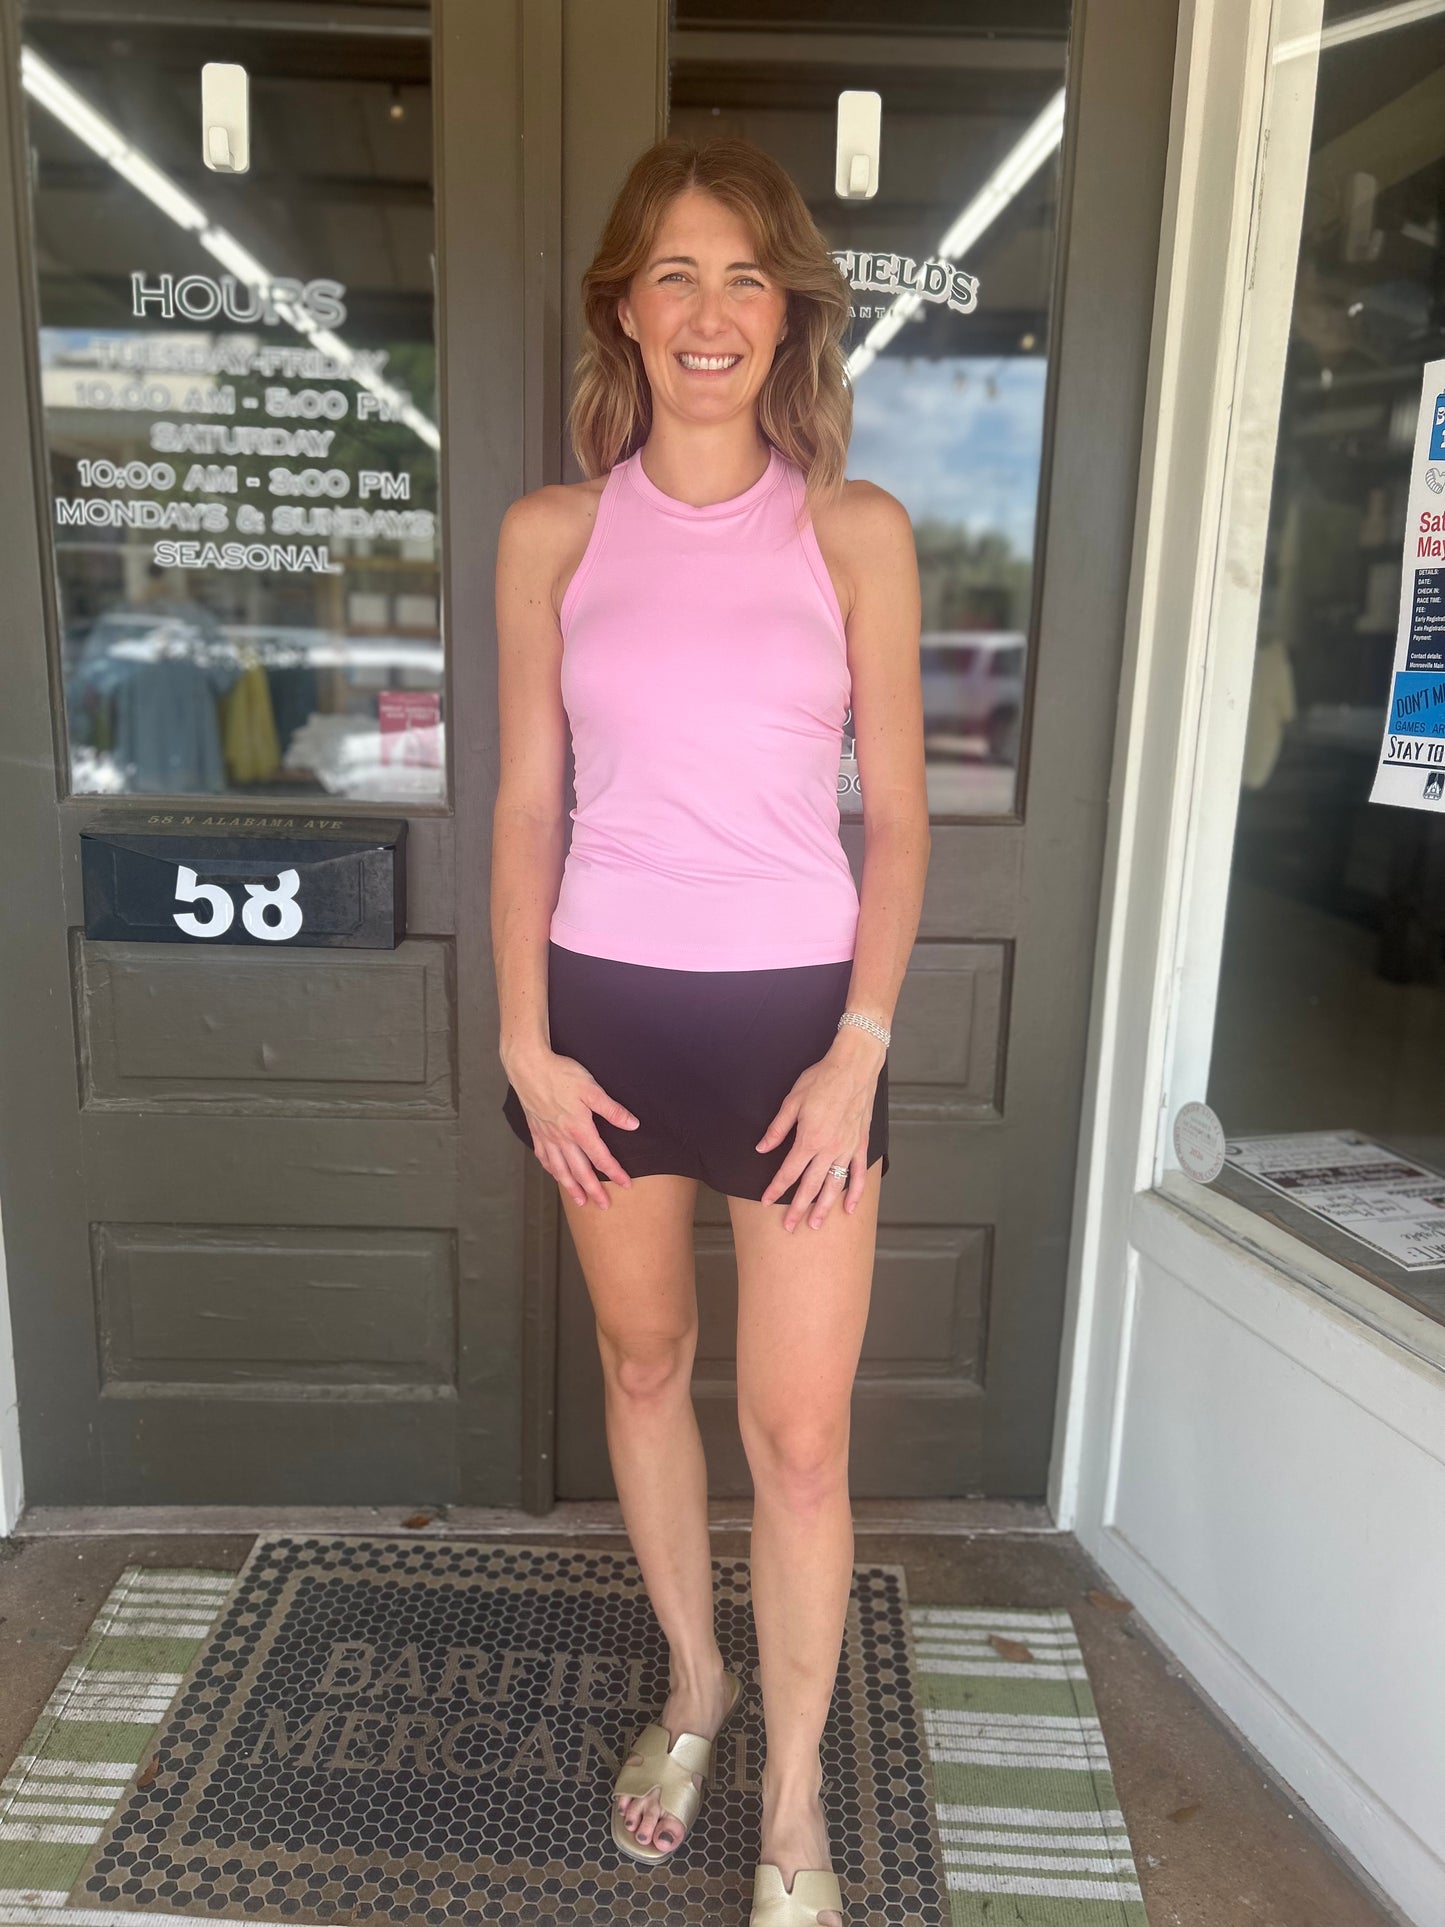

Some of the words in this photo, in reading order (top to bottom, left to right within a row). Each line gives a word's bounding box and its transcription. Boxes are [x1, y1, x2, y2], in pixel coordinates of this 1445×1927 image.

[131, 272, 347, 329] HOURS
[75, 380, 171, 411] 10:00
[183, 385, 236, 414] AM
[265, 387, 349, 420] 5:00
[150, 422, 336, 458] SATURDAY
[78, 460, 176, 491] 10:00
[182, 464, 238, 493] AM
[268, 467, 350, 498] 3:00
[358, 470, 410, 500] PM
[56, 498, 229, 533] MONDAYS
[236, 504, 265, 534] &
[272, 505, 434, 541] SUNDAYS
[153, 541, 344, 574] SEASONAL
[1396, 688, 1429, 718] DON'T
[1395, 721, 1426, 733] GAMES
[1388, 735, 1424, 760] STAY
[147, 815, 175, 824] 58
[181, 816, 194, 825] N
[202, 817, 294, 828] ALABAMA
[304, 820, 344, 830] AVE
[173, 865, 303, 941] 58
